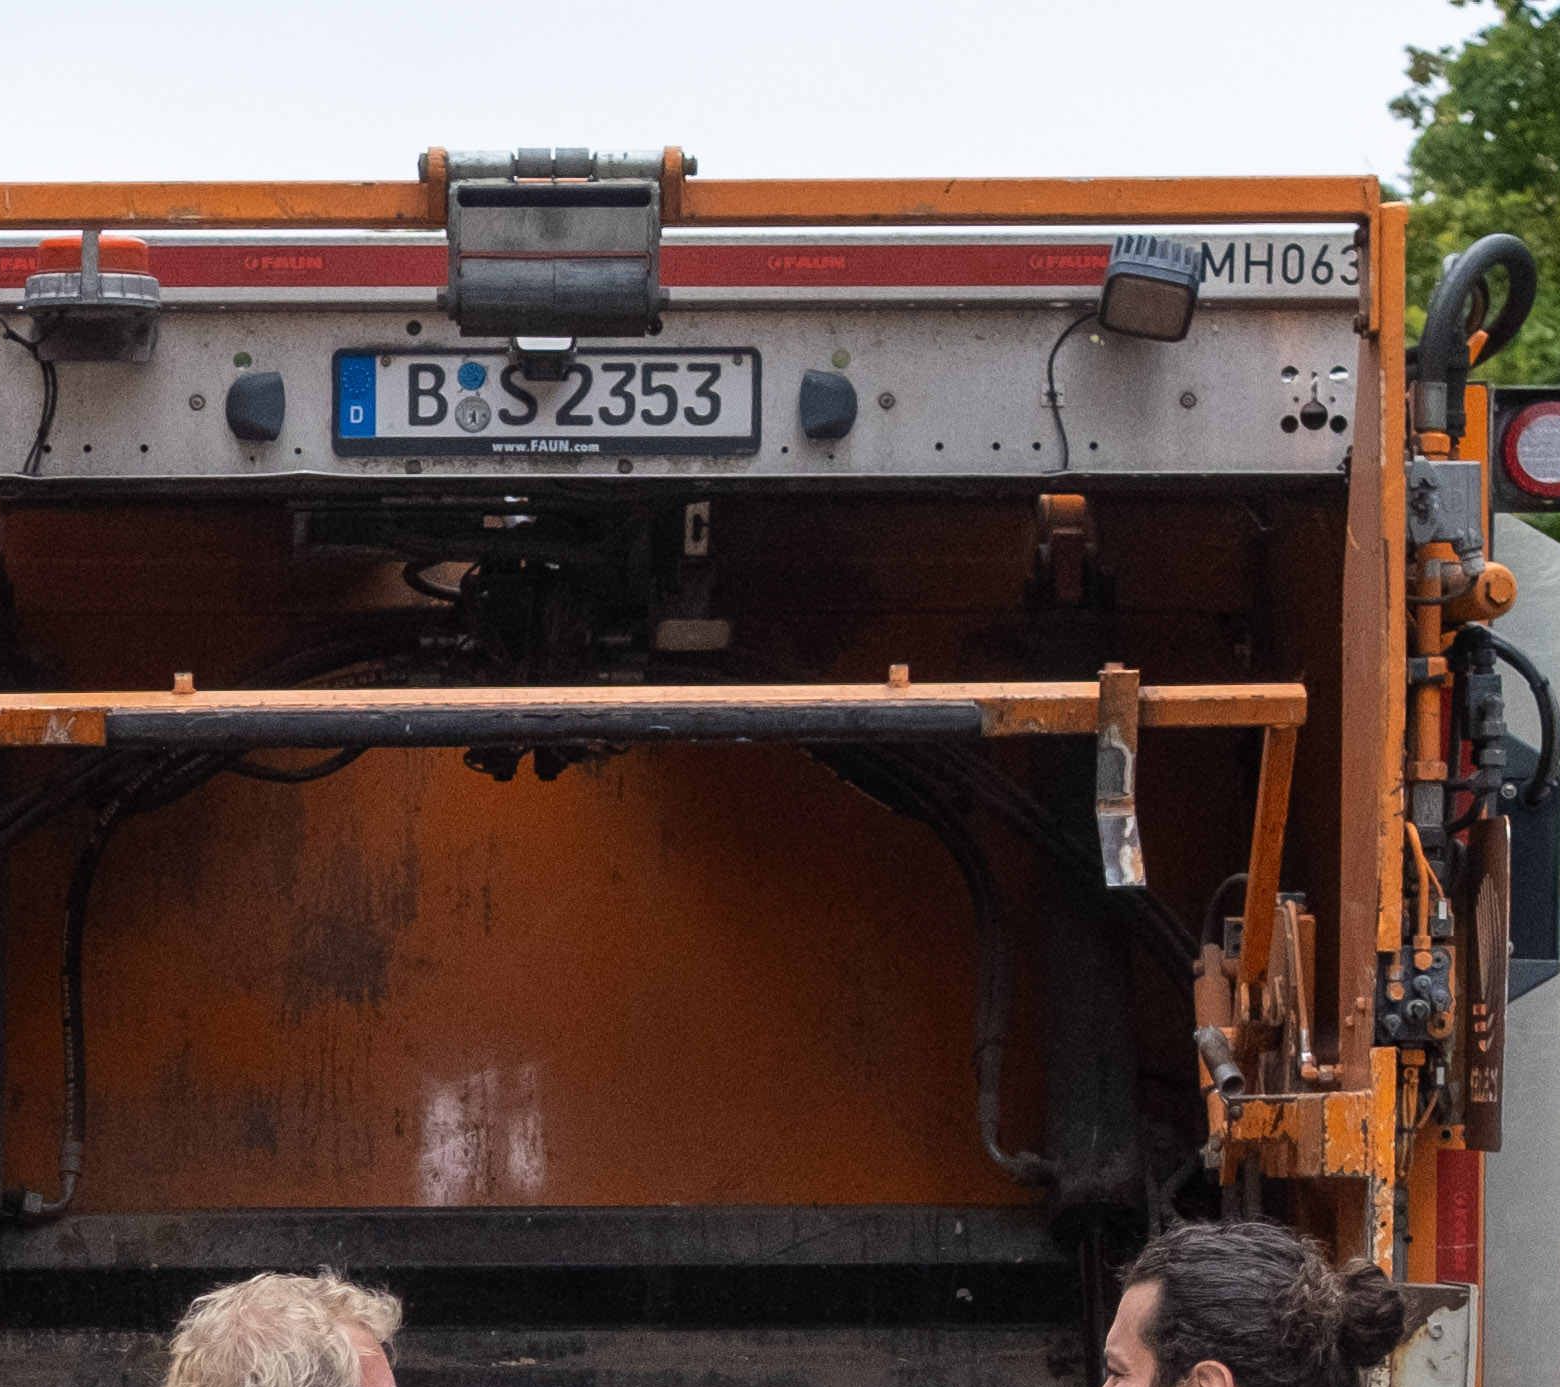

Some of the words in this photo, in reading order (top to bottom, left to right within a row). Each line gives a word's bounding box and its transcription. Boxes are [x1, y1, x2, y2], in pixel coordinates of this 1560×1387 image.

[408, 363, 449, 427] B
[498, 363, 539, 427] S
[555, 362, 722, 427] 2353
[350, 408, 364, 424] D
[492, 439, 600, 453] www.FAUN.com
